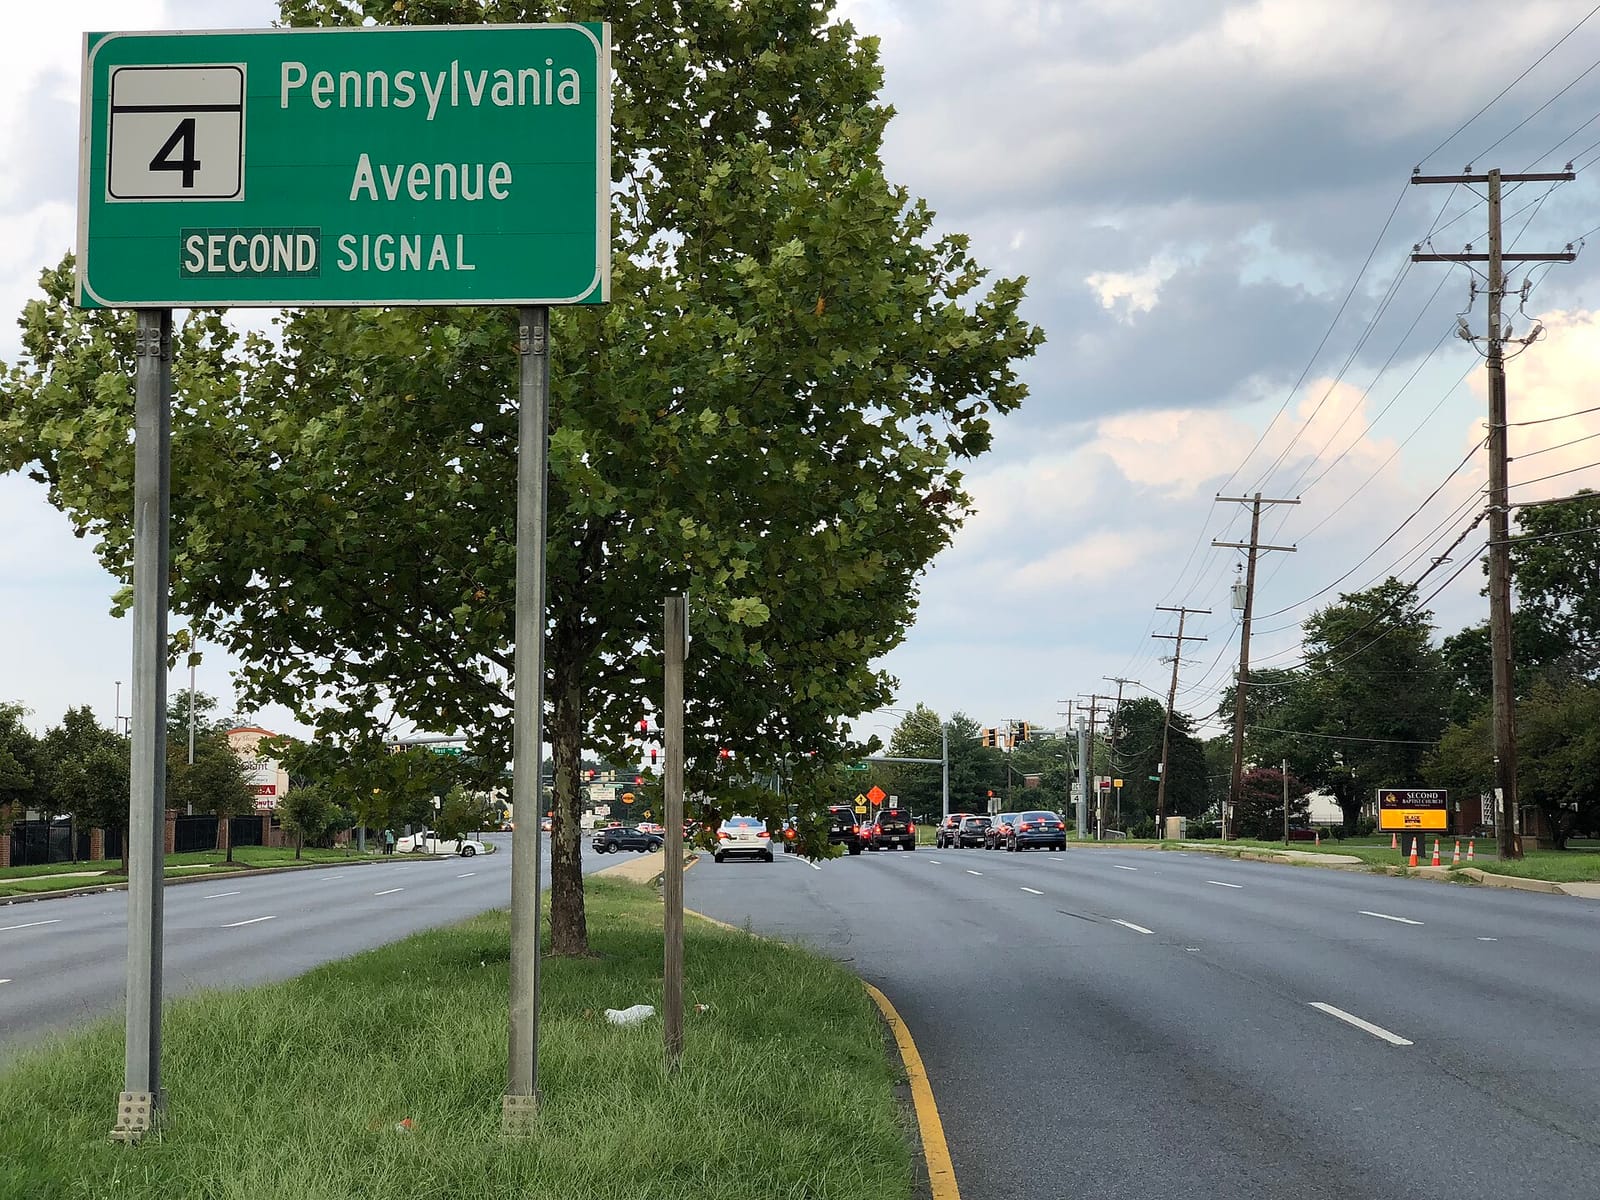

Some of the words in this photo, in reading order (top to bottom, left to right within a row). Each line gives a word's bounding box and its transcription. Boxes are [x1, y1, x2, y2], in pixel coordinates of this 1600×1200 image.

[280, 58, 581, 121] Pennsylvania
[148, 117, 201, 189] 4
[349, 153, 513, 201] Avenue
[184, 233, 317, 273] SECOND
[336, 233, 476, 272] SIGNAL
